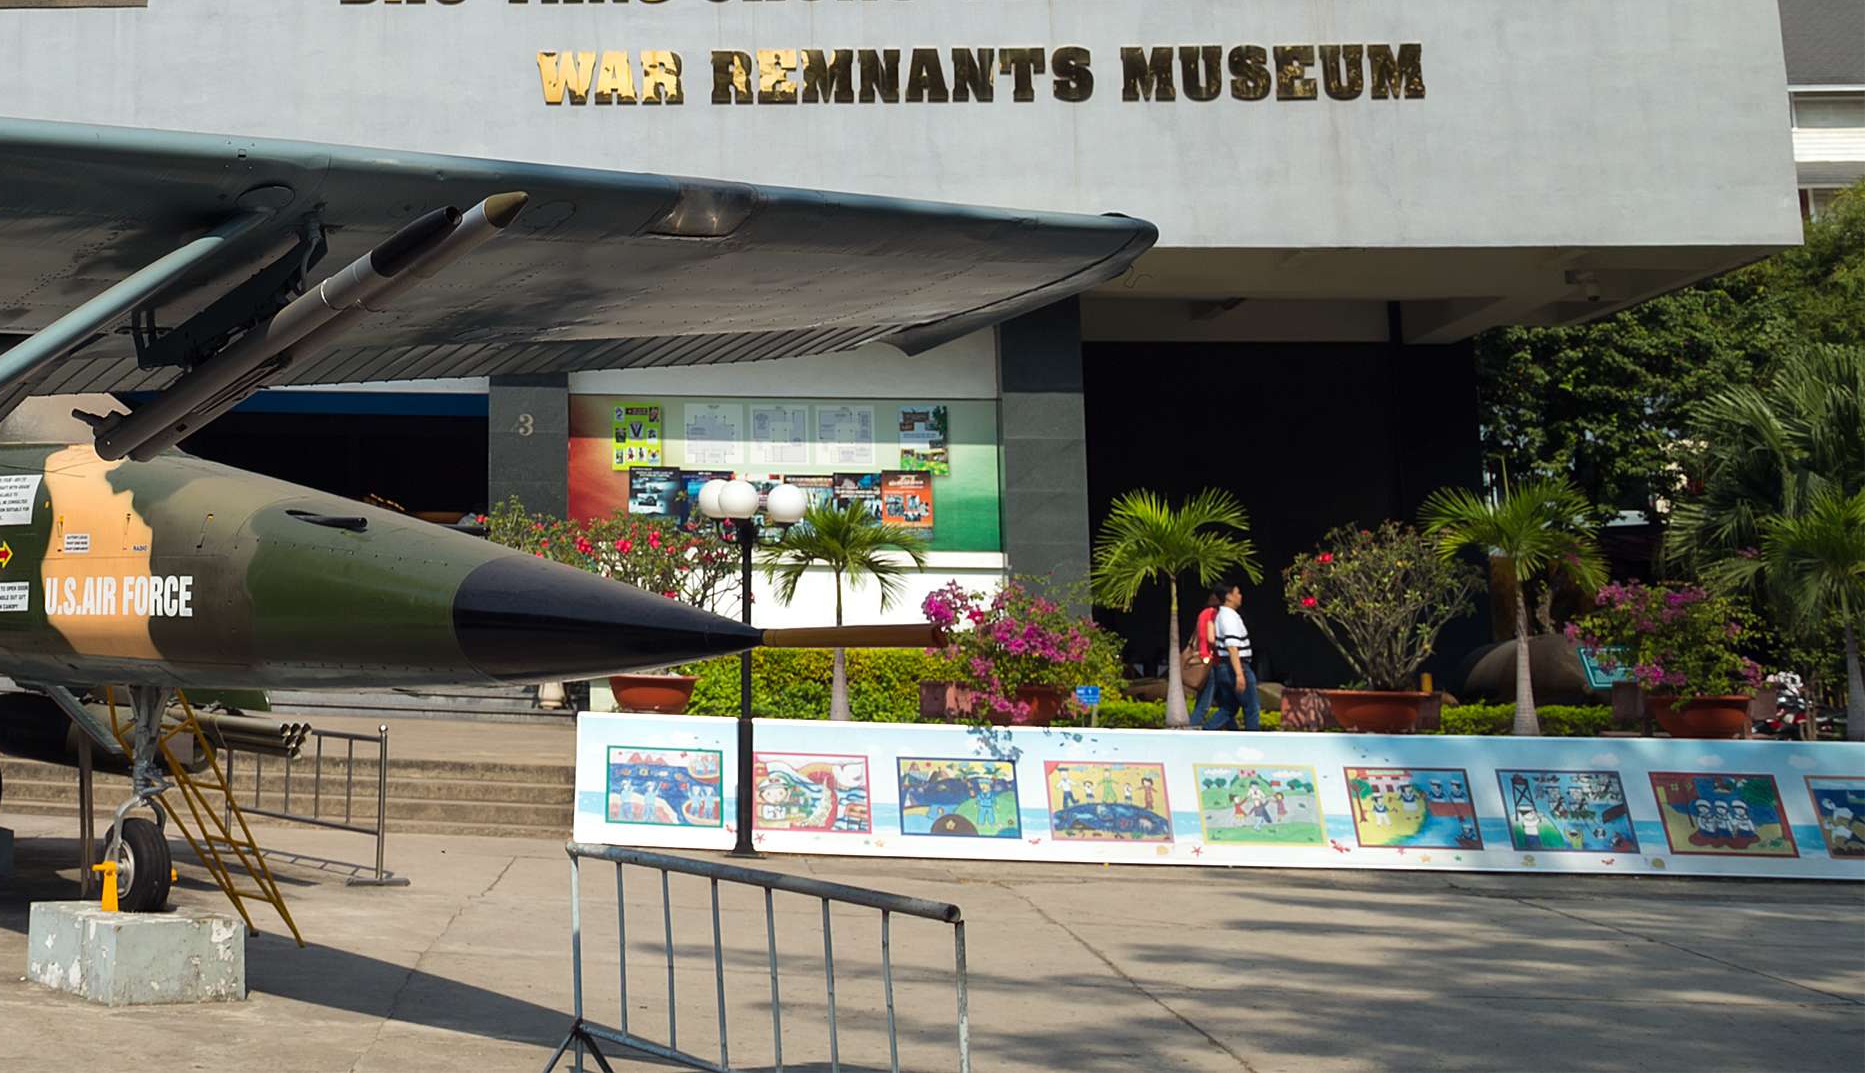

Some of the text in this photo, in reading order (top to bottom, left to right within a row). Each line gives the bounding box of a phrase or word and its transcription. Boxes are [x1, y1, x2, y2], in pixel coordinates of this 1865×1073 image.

[536, 42, 1426, 105] WAR REMNANTS MUSEUM
[519, 413, 534, 436] 3
[44, 575, 193, 617] U.S.AIR FORCE
